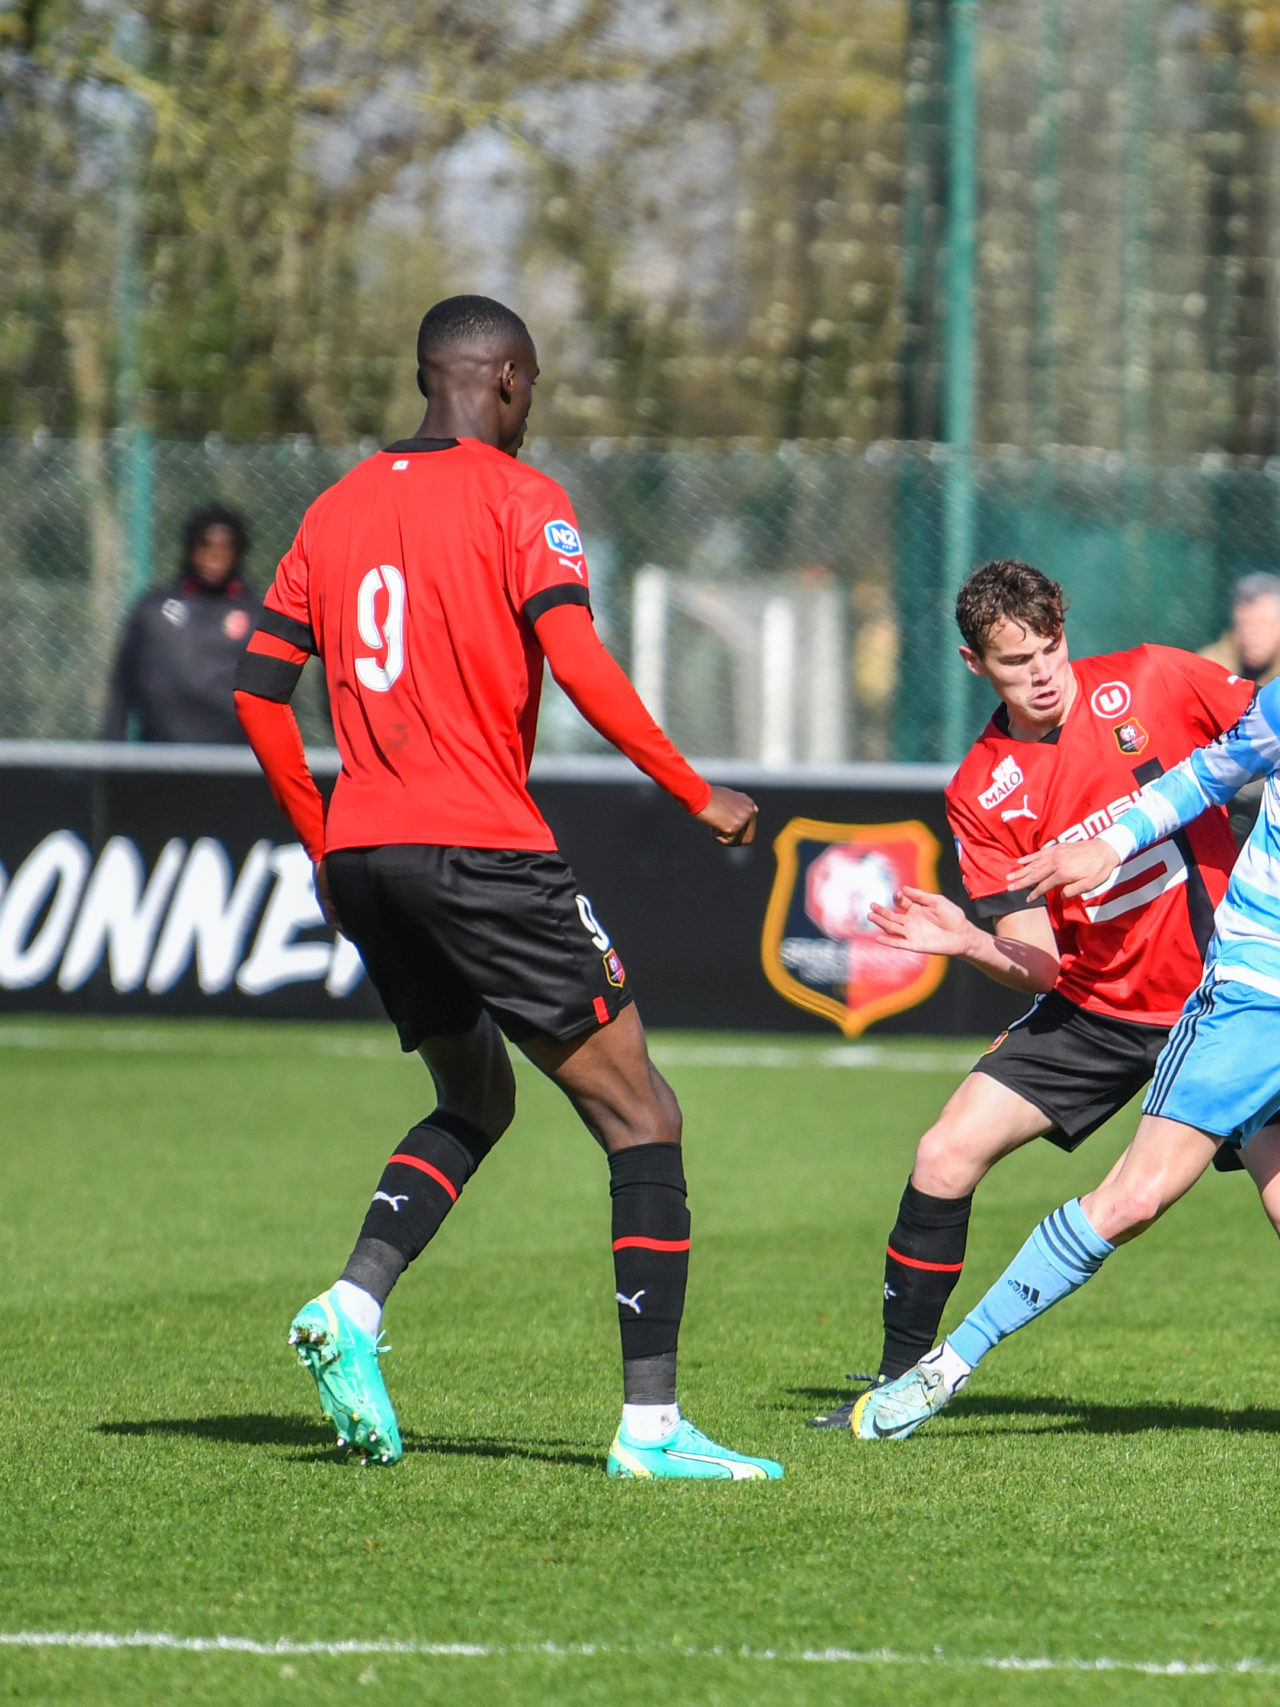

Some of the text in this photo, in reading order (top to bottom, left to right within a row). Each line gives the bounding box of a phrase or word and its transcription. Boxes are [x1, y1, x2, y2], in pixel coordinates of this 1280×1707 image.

[550, 527, 577, 547] N2
[354, 564, 405, 692] 9
[985, 771, 1020, 807] MALO
[0, 829, 366, 998] ONNE
[575, 894, 609, 952] 9
